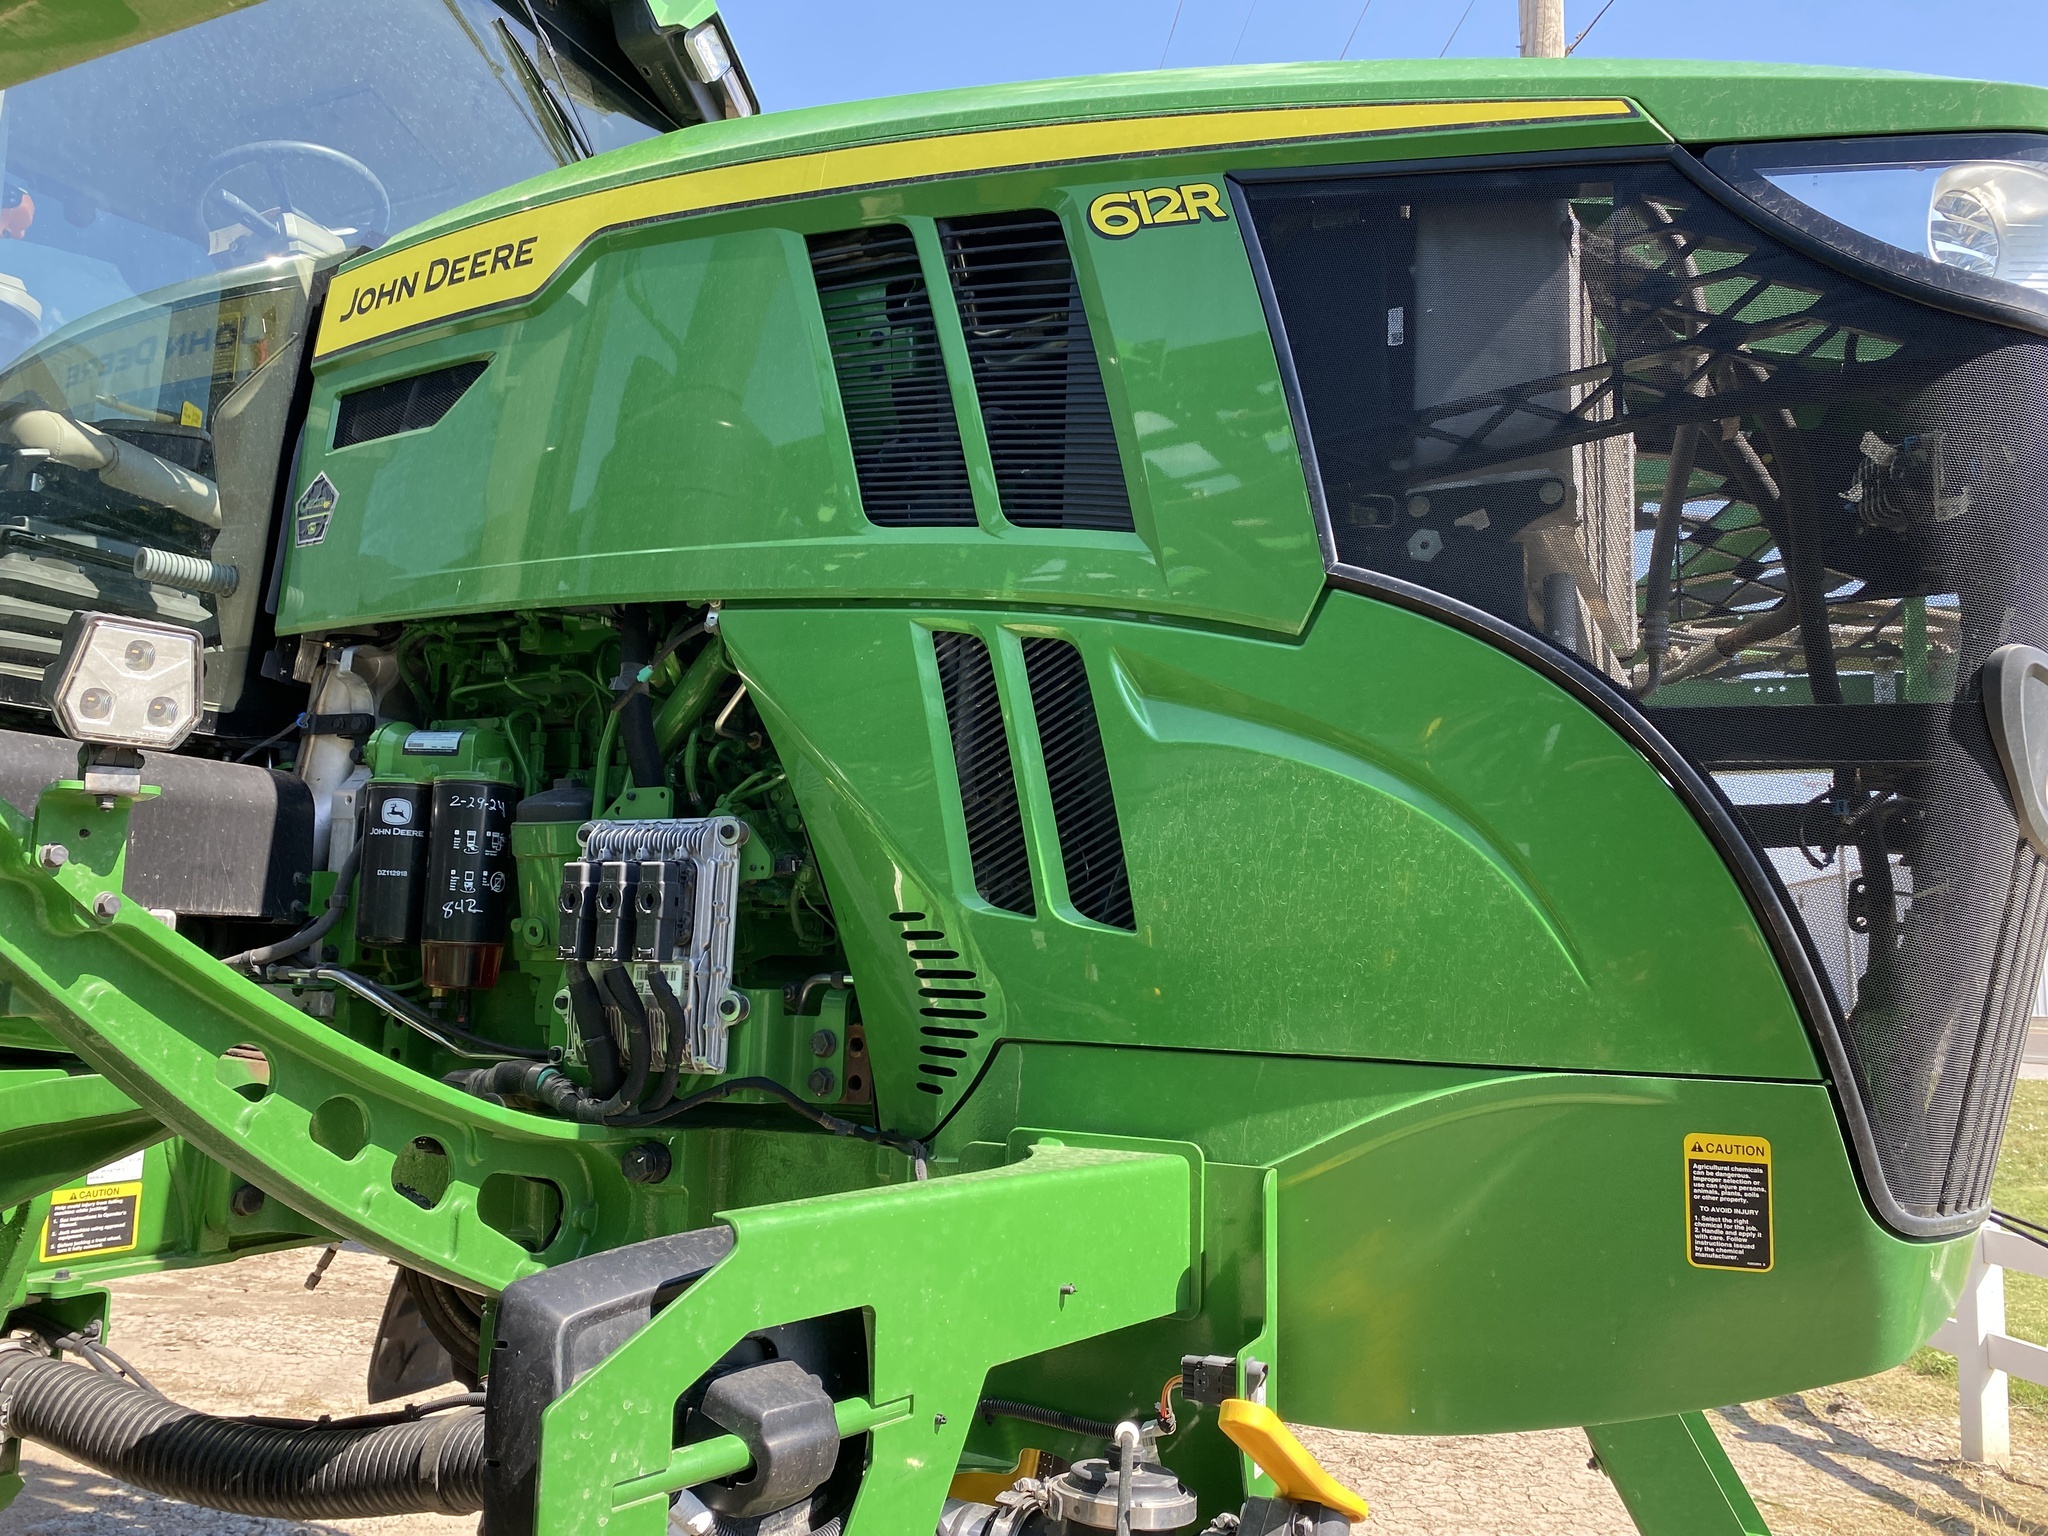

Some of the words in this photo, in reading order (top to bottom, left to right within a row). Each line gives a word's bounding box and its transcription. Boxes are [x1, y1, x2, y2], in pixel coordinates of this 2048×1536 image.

[1087, 182, 1230, 240] 612R
[340, 271, 420, 322] JOHN
[424, 236, 538, 293] DEERE
[450, 795, 506, 818] 2-29-24
[370, 827, 391, 836] JOHN
[393, 828, 424, 837] DEERE
[442, 899, 483, 919] 842
[1706, 1143, 1765, 1156] CAUTION
[79, 1188, 120, 1198] CAUTION
